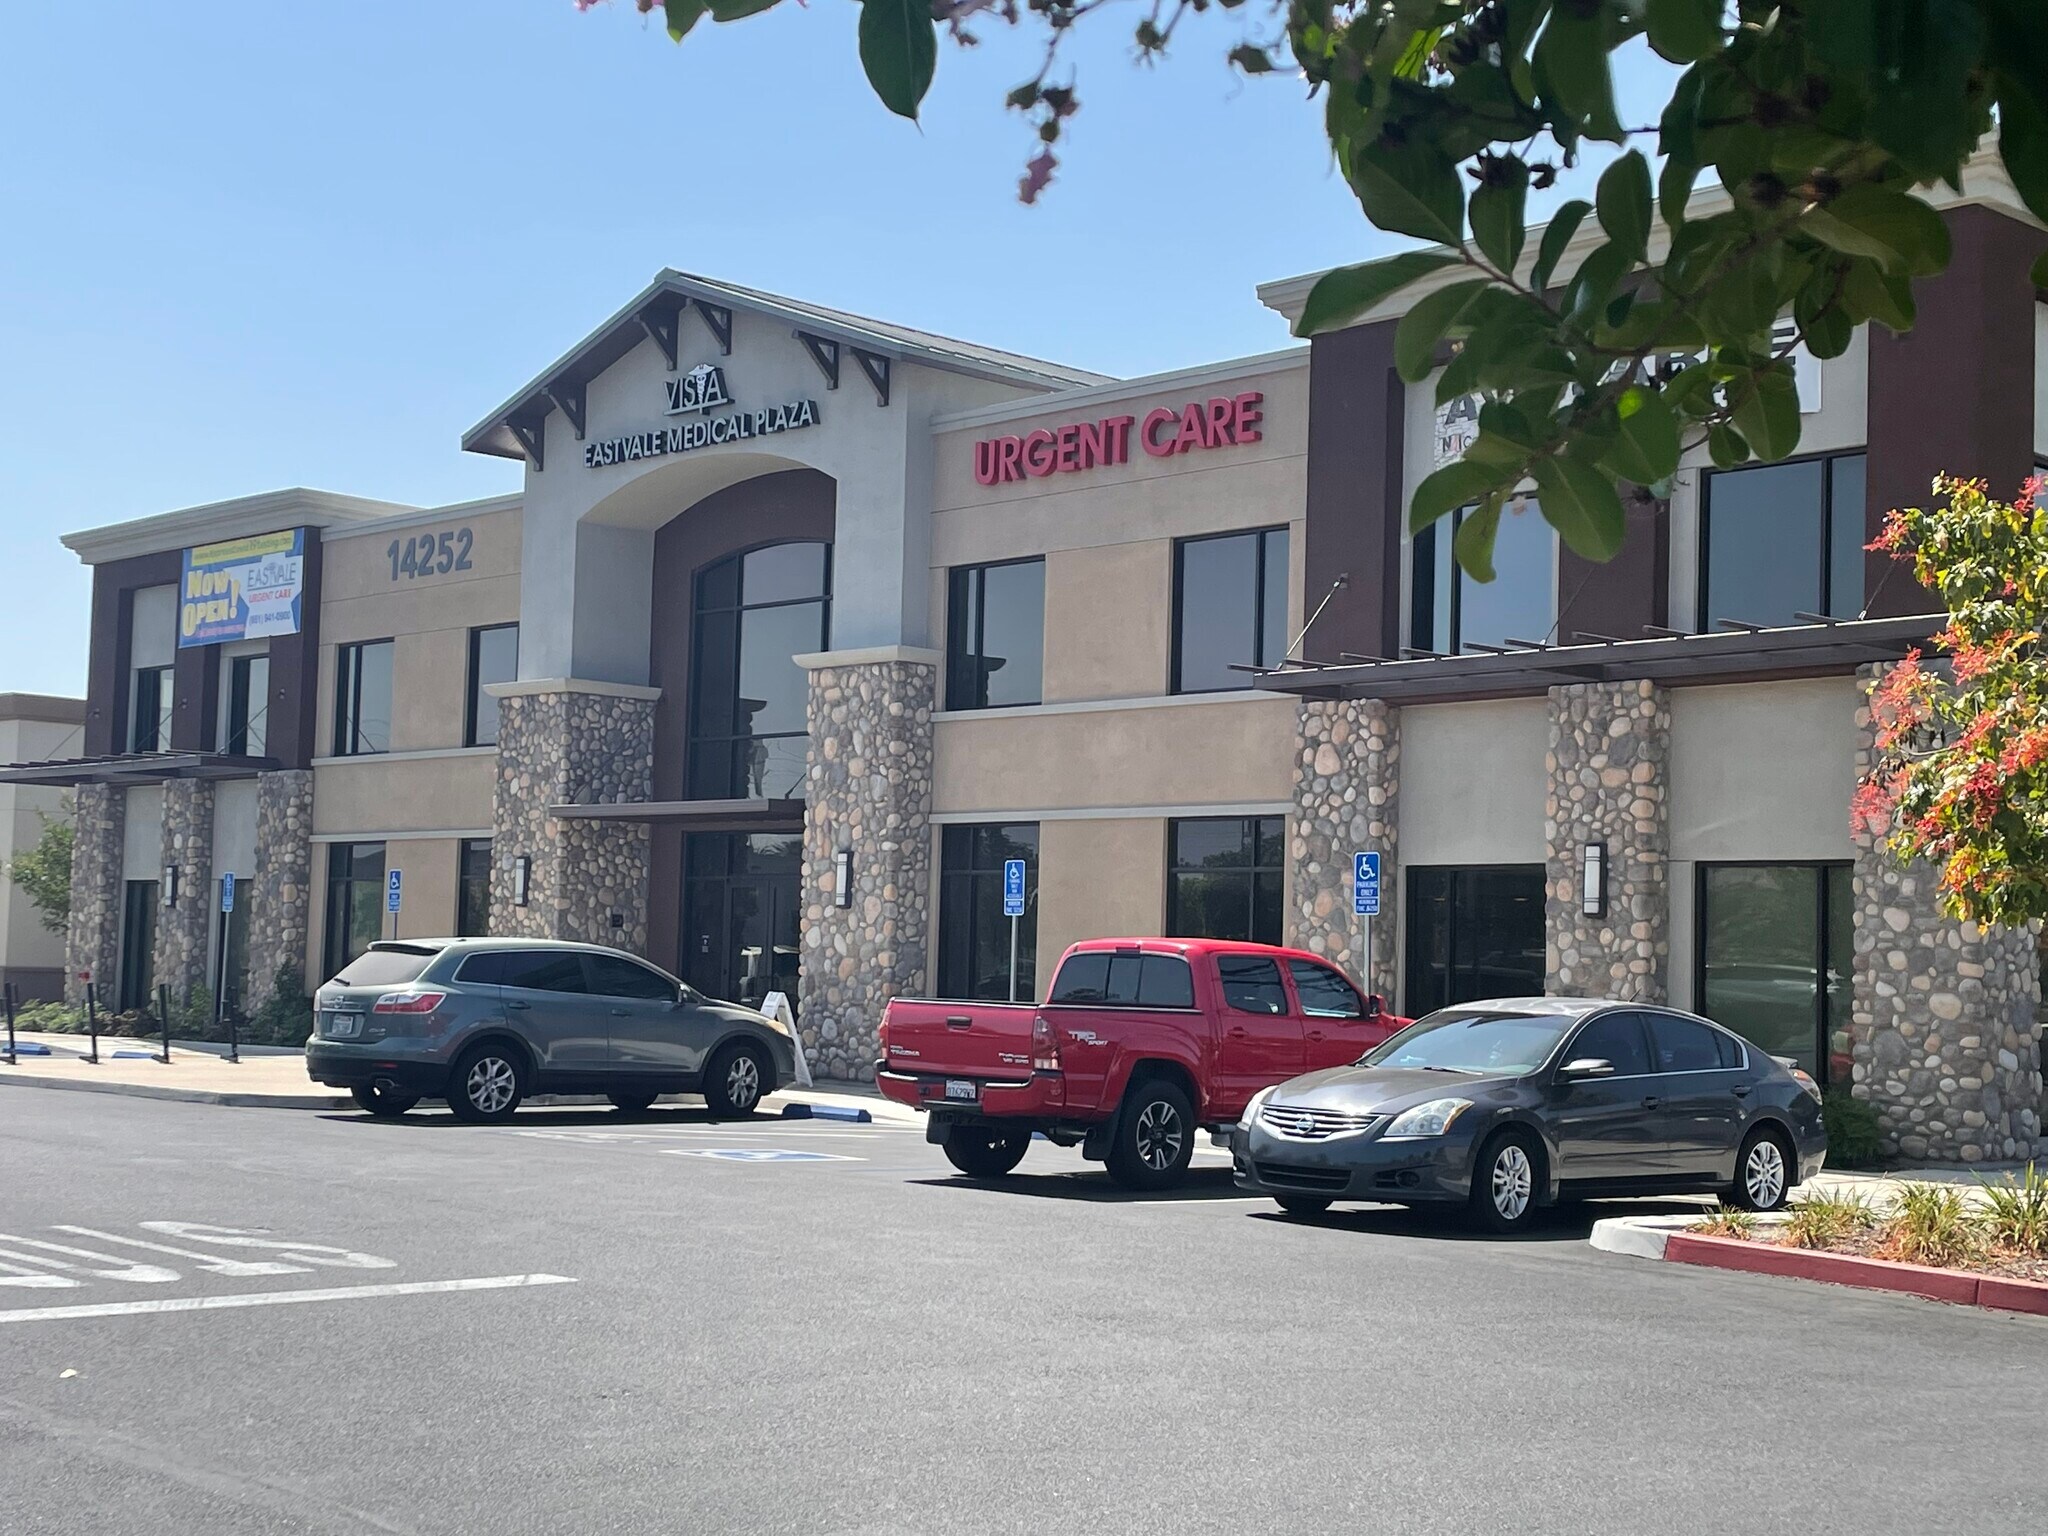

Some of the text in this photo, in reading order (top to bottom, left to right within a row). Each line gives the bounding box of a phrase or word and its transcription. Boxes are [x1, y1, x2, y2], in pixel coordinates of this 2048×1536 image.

[663, 363, 727, 414] VISTA
[584, 400, 818, 468] EASTVALE MEDICAL PLAZA
[975, 392, 1264, 486] URGENT CARE
[387, 528, 473, 581] 14252
[275, 588, 292, 600] CARE
